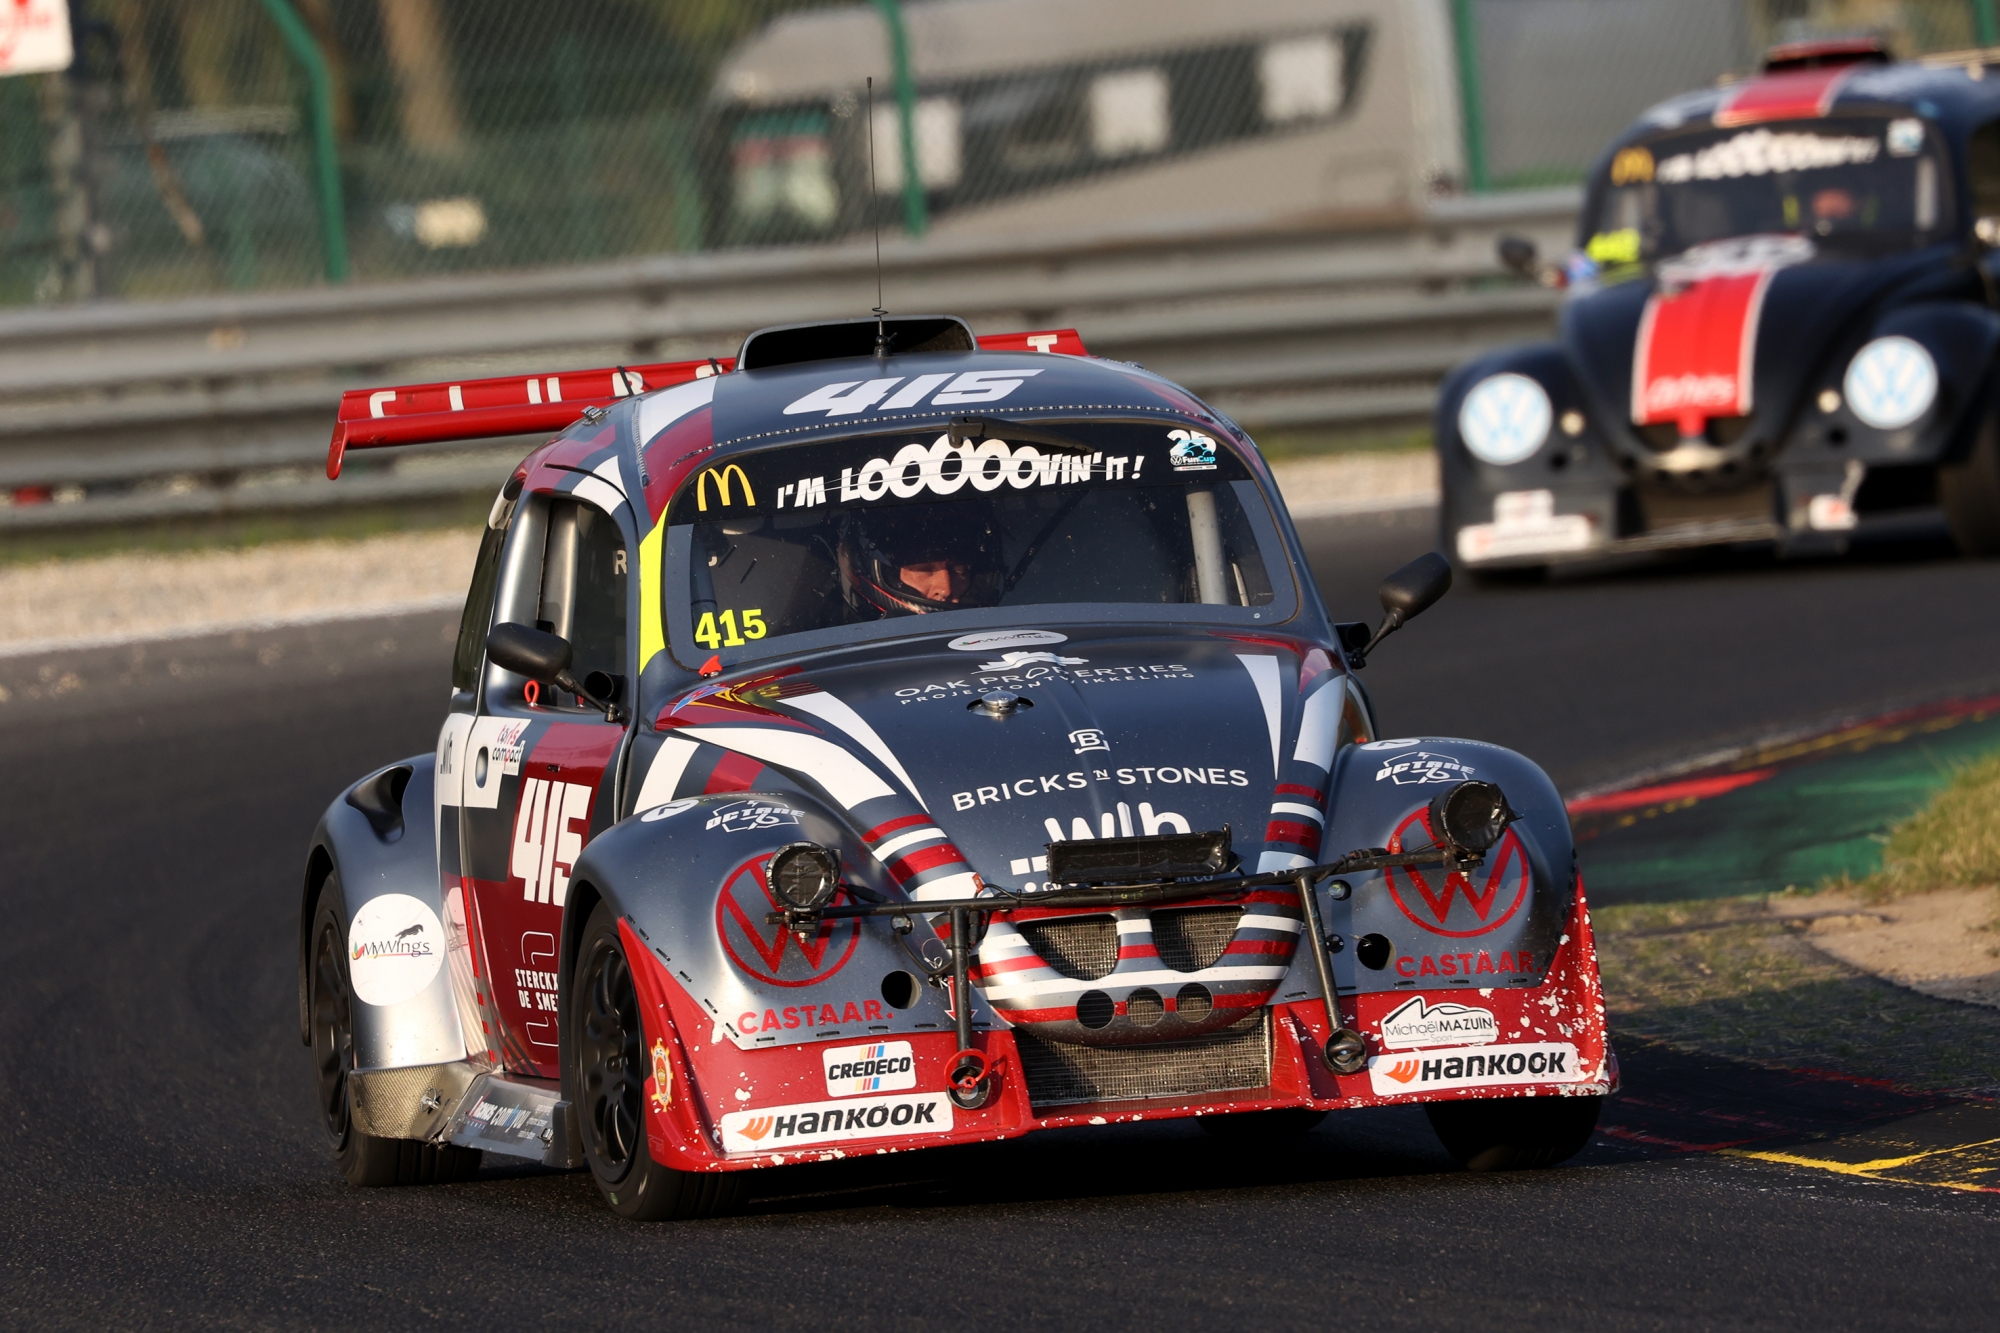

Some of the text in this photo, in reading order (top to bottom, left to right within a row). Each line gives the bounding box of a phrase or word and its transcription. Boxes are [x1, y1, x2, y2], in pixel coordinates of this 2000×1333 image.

[782, 368, 1046, 417] 415
[777, 476, 826, 509] I'M
[694, 608, 767, 650] 415
[894, 663, 1188, 697] OAK PROPERTIES
[1375, 761, 1476, 781] OCTANE
[952, 767, 1250, 811] BRICKS N STONES
[705, 807, 806, 831] OCTANE
[512, 777, 592, 907] 415
[514, 968, 558, 990] STERCKX
[1395, 950, 1543, 978] CASTAAR.
[518, 989, 558, 1012] DE SME
[737, 1000, 894, 1034] CASTAAR.
[1430, 1034, 1453, 1044] Sport
[828, 1056, 911, 1081] CREDECO
